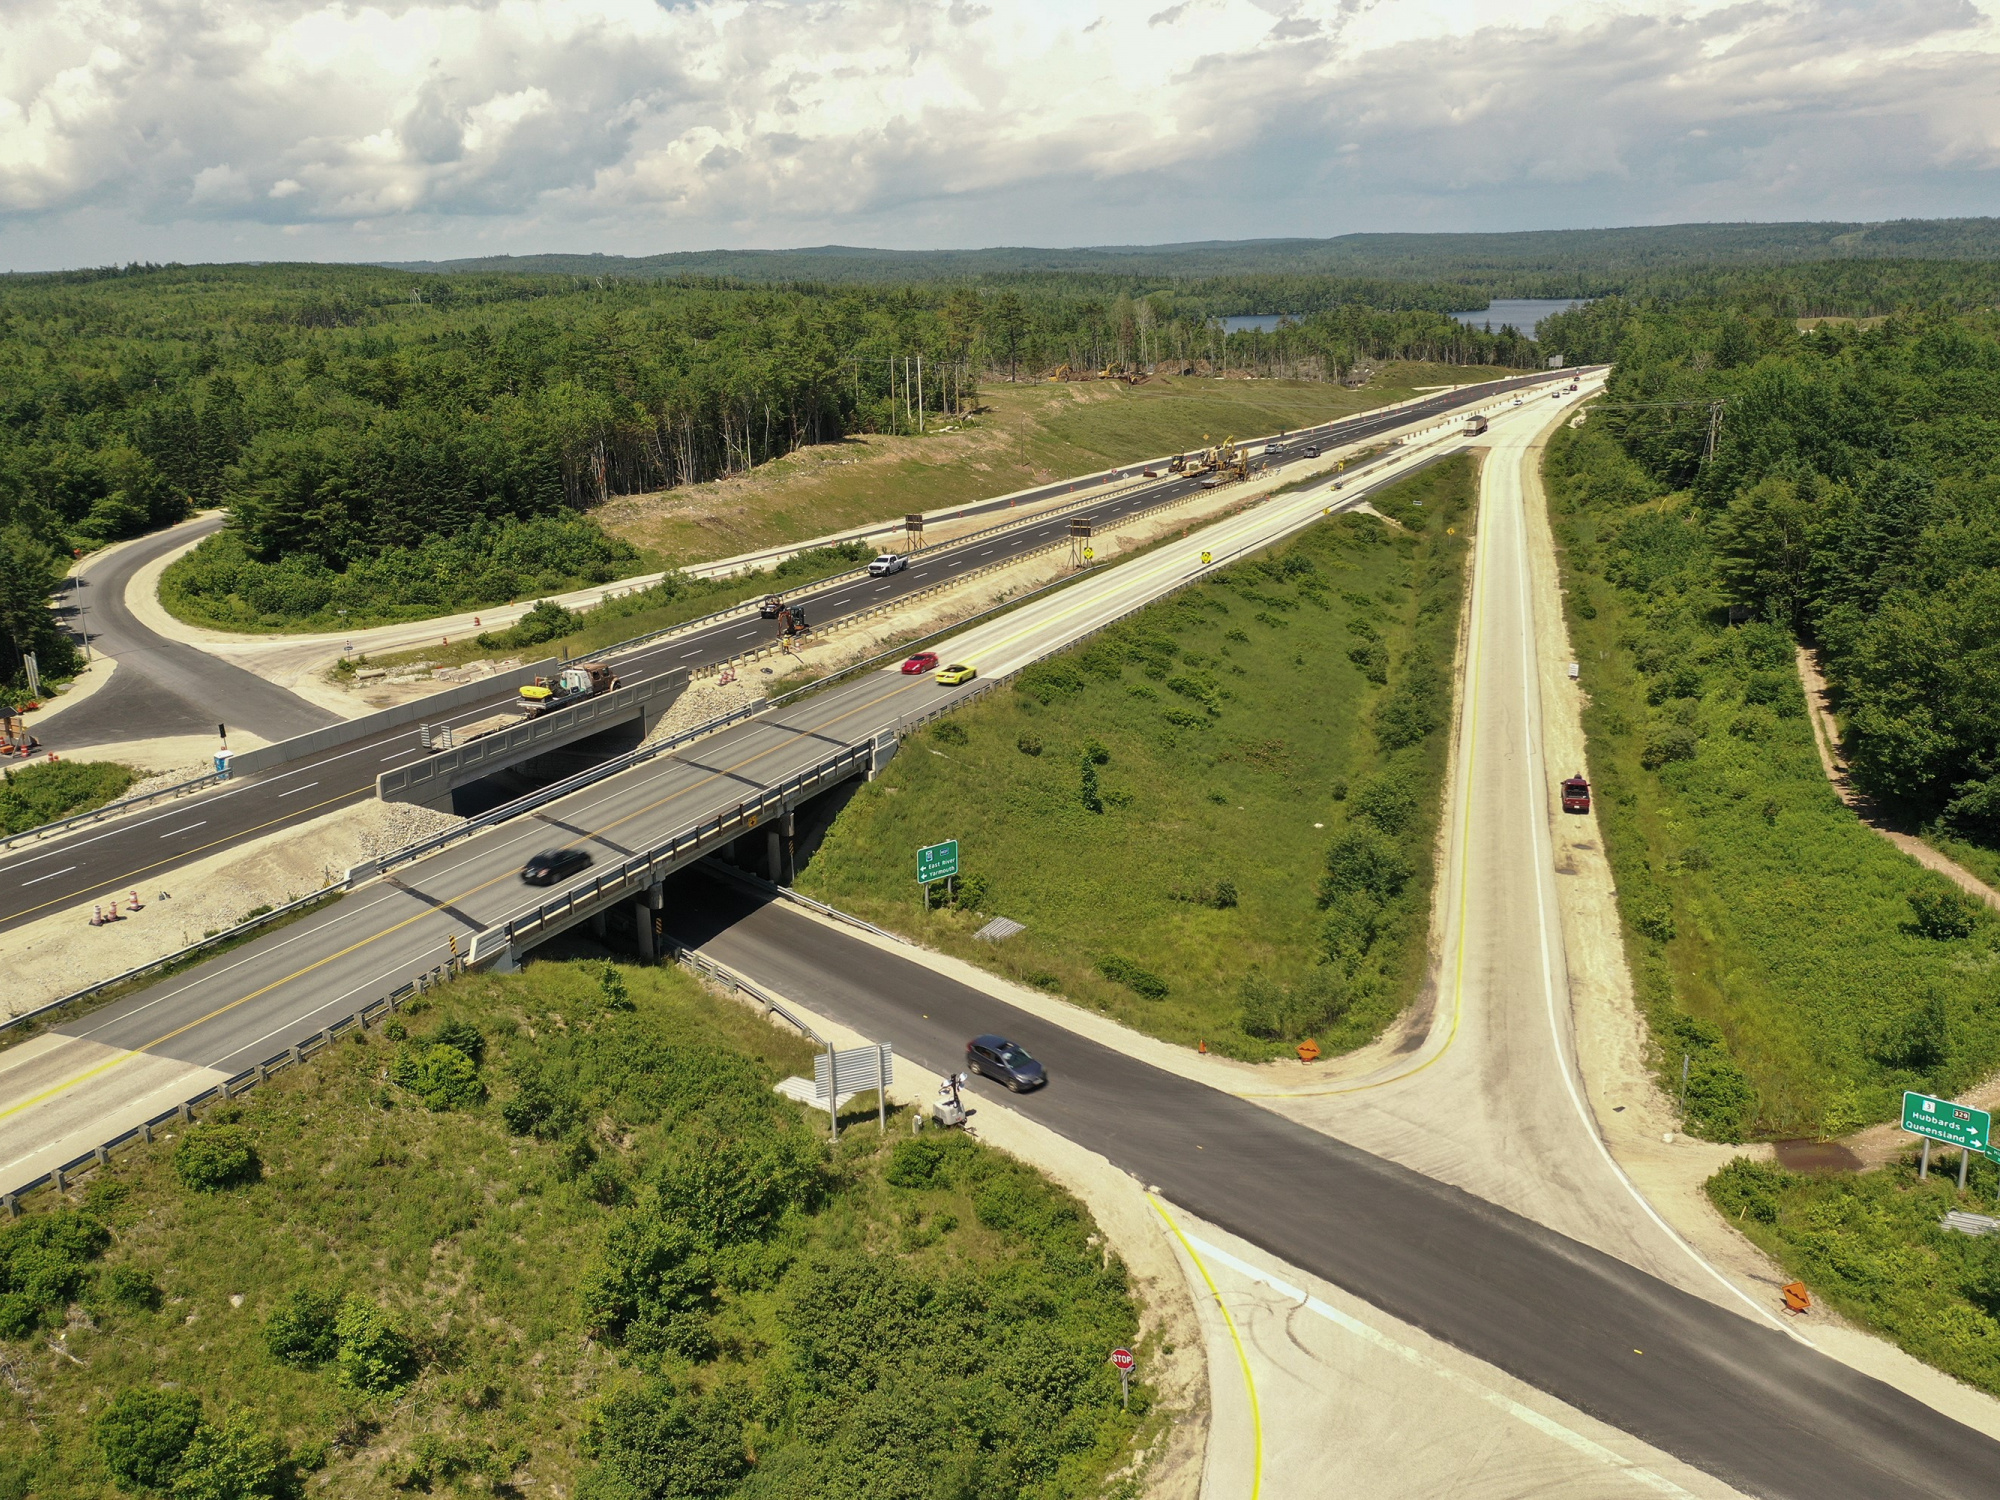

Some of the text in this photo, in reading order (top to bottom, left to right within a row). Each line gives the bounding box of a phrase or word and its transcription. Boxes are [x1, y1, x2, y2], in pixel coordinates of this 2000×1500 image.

[930, 866, 955, 876] Yarmouth
[1954, 1110, 1968, 1119] 329
[1912, 1111, 1961, 1131] Hubbards
[1905, 1120, 1965, 1143] Queensland
[1112, 1354, 1131, 1363] STOP
